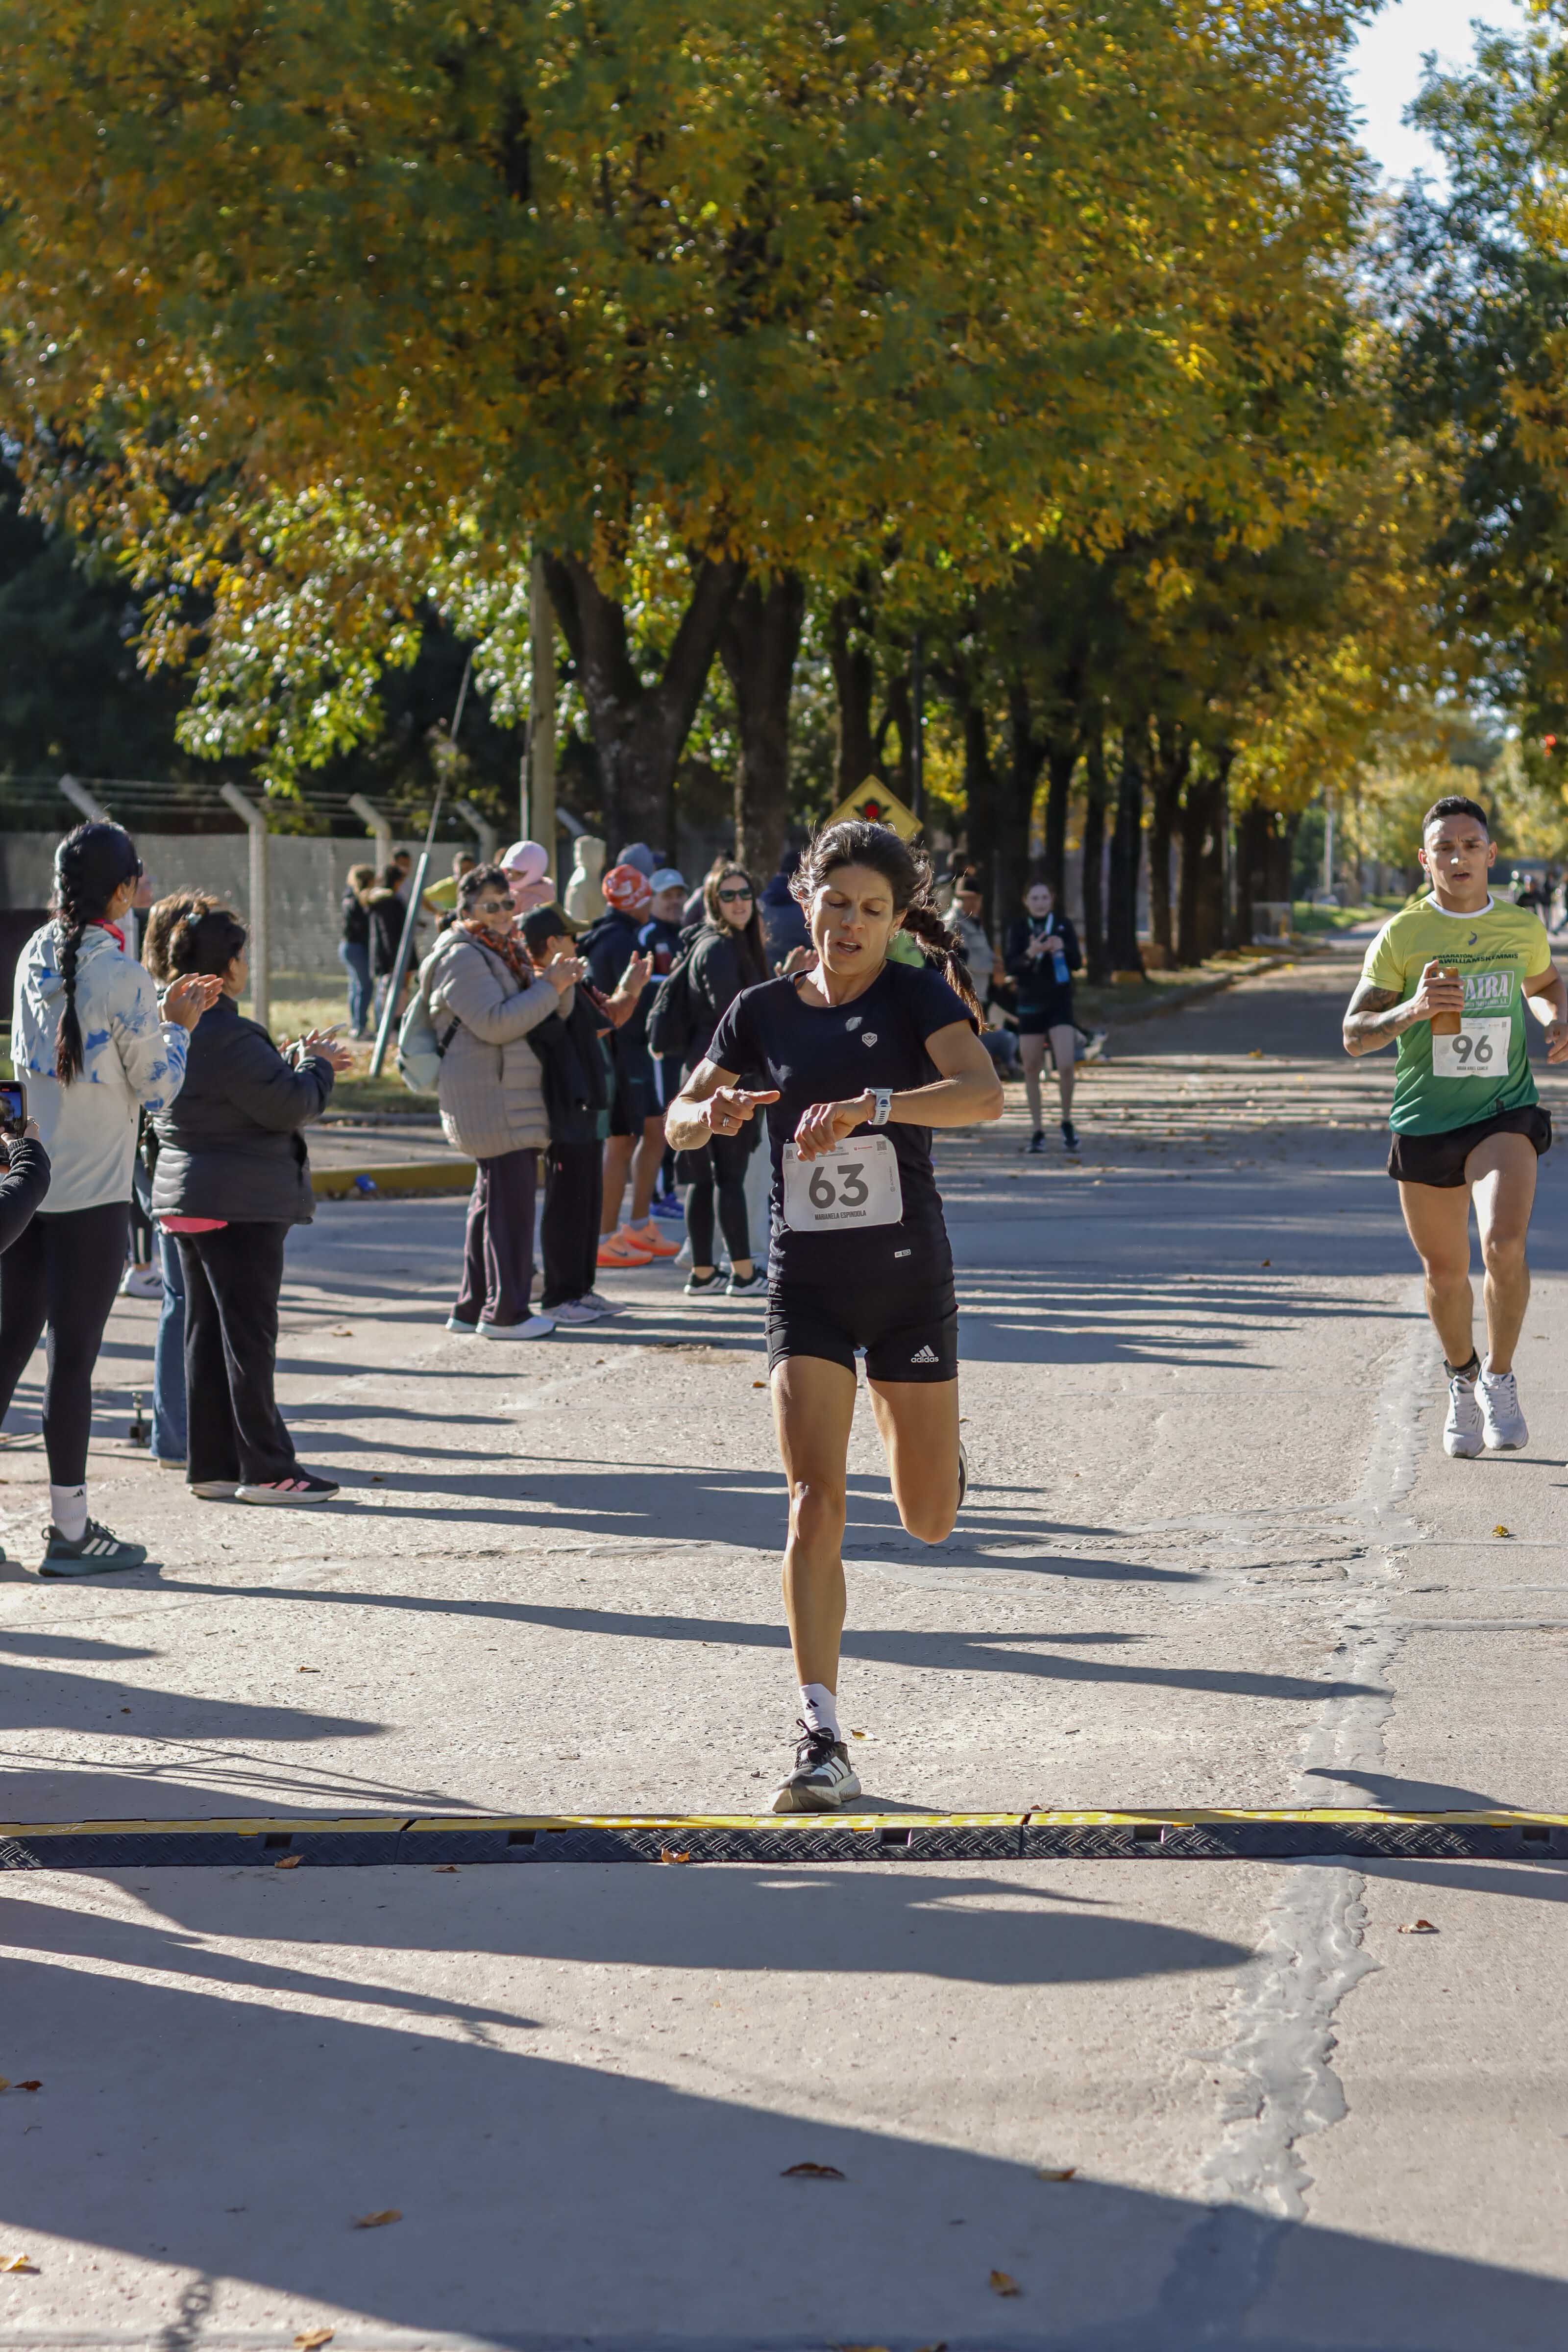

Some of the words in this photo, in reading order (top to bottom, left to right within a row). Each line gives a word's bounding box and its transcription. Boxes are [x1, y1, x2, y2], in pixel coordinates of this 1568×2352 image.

[1452, 1035, 1493, 1063] 96
[809, 1163, 868, 1209] 63
[840, 1210, 866, 1219] ESPINDOLA
